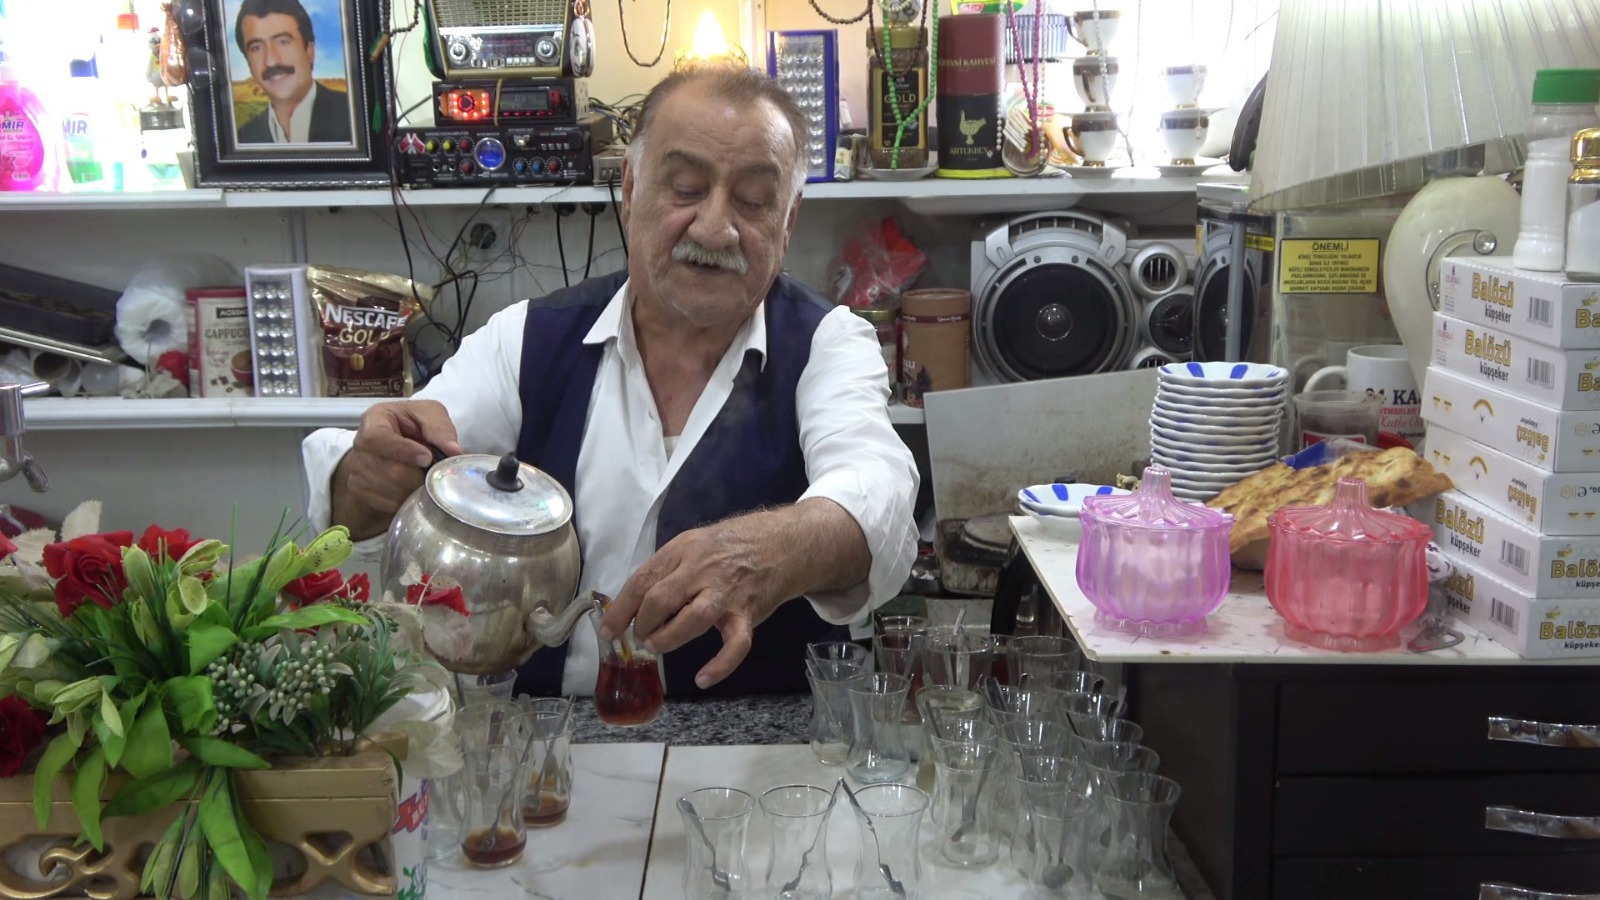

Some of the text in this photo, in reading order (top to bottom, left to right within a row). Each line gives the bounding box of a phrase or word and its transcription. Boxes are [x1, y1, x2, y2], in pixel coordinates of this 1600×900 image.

[964, 56, 996, 66] KAHVESİ
[1312, 240, 1349, 251] ÖNEMLİ
[1472, 272, 1515, 308] Balözü
[1484, 304, 1511, 324] küpşeker
[1464, 329, 1512, 367] Balözü
[1479, 360, 1509, 382] küpşeker
[1392, 389, 1422, 405] KA
[1436, 498, 1485, 544] Balözü
[1450, 534, 1481, 558] küpşeker
[1551, 558, 1600, 578] Balö
[1448, 566, 1474, 601] özü
[1540, 620, 1600, 639] Balöz
